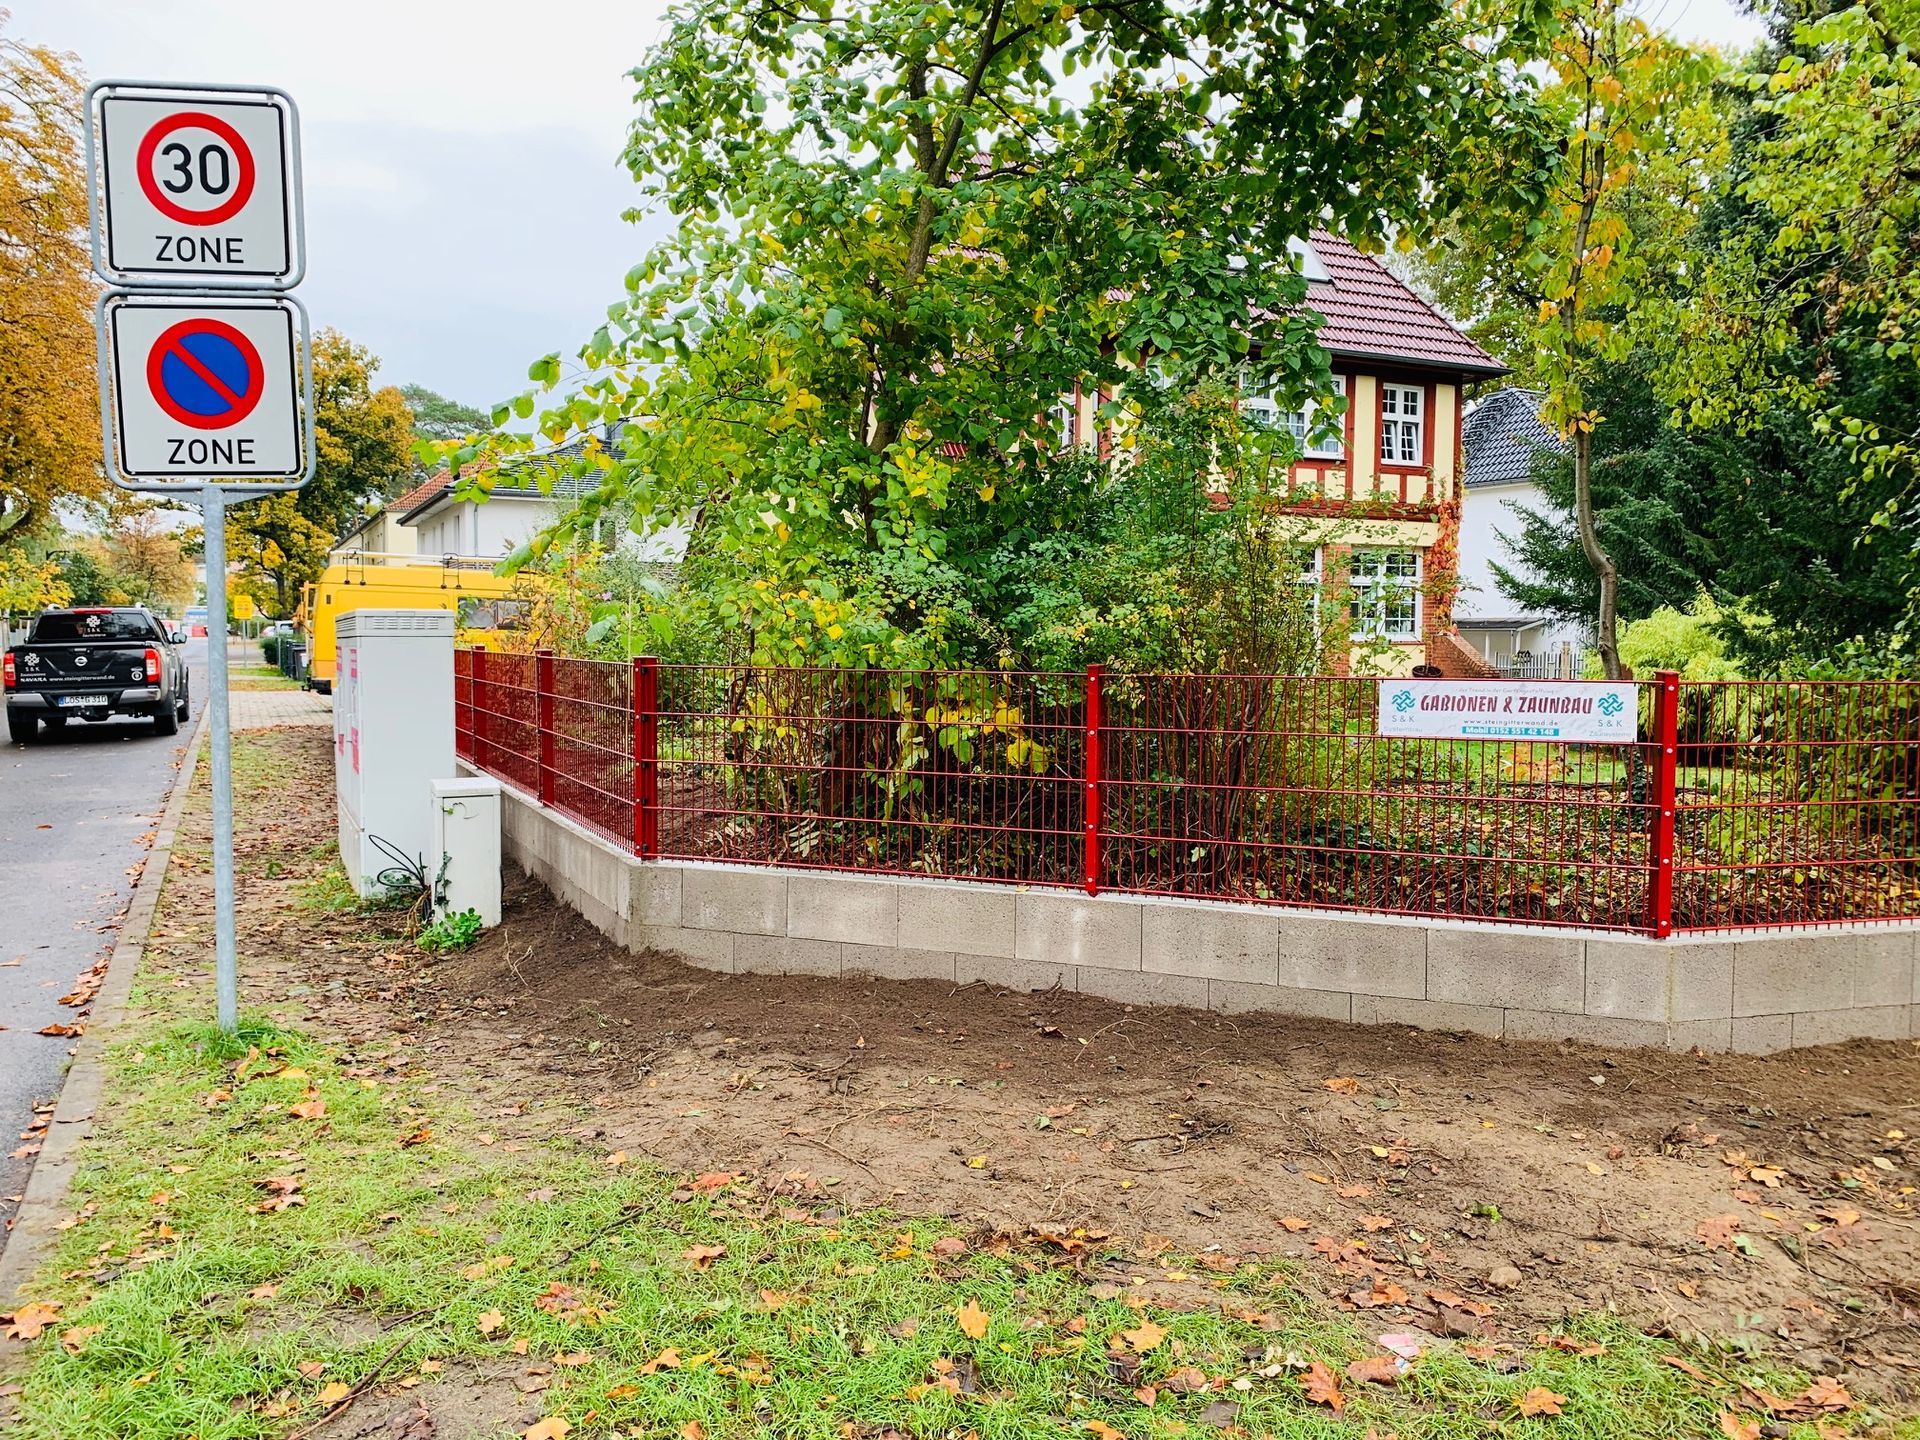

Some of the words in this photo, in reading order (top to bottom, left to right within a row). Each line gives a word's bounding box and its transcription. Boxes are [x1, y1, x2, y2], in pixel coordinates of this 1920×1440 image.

[161, 142, 230, 195] 30
[155, 235, 244, 264] ZONE
[167, 438, 256, 465] ZONE
[1420, 694, 1498, 713] GABIONEN
[1503, 696, 1513, 714] &
[1518, 696, 1593, 715] ZAUNBAU
[1464, 719, 1558, 727] www.steingitterwand.de
[1465, 726, 1488, 734] Mobil
[1490, 727, 1510, 735] 0152
[1540, 728, 1555, 736] 148
[1598, 719, 1604, 727] S
[1606, 719, 1613, 727] &
[1617, 719, 1623, 727] K
